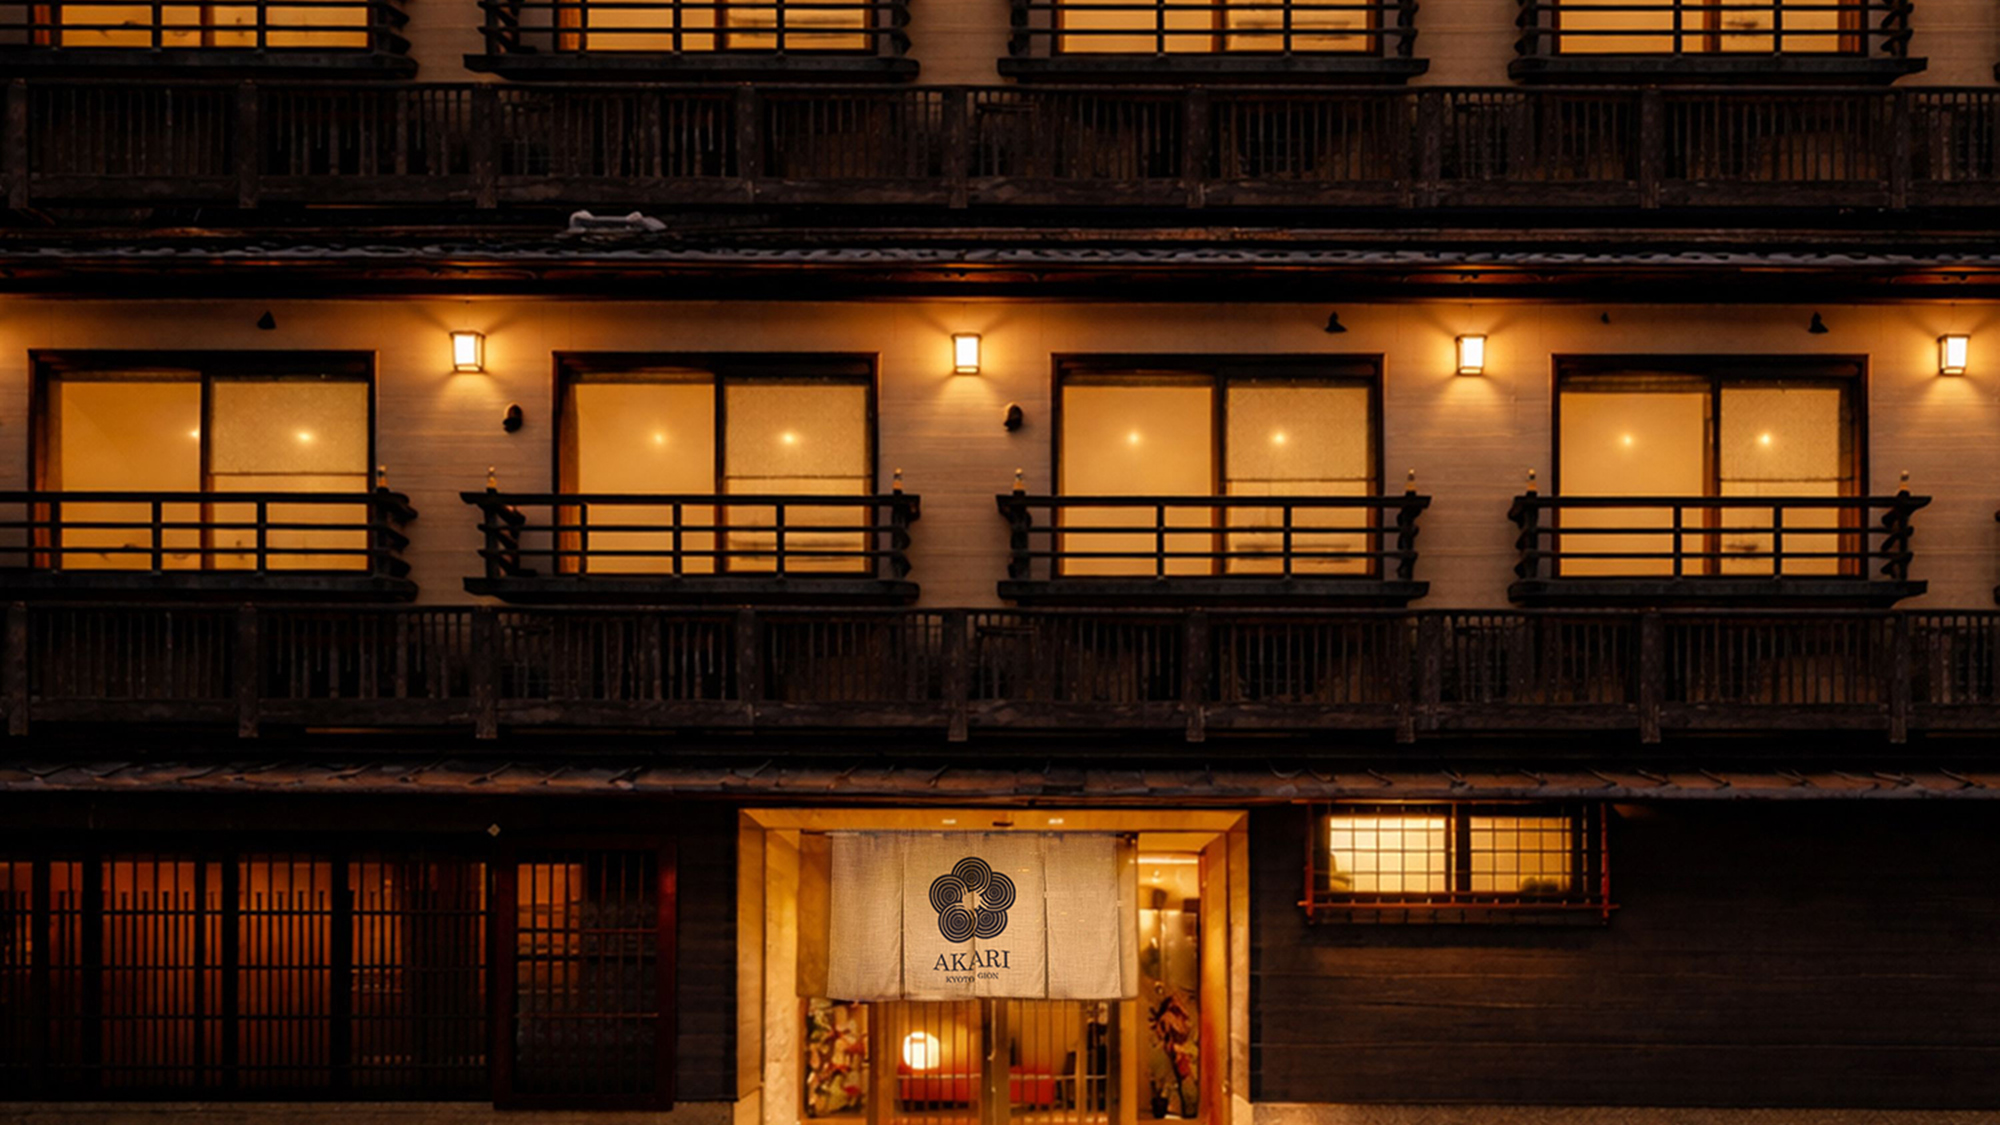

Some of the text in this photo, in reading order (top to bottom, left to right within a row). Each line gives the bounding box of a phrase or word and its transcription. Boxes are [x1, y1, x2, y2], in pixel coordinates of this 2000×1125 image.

[933, 949, 1010, 971] AKARI
[946, 971, 999, 983] KYOTO GION
